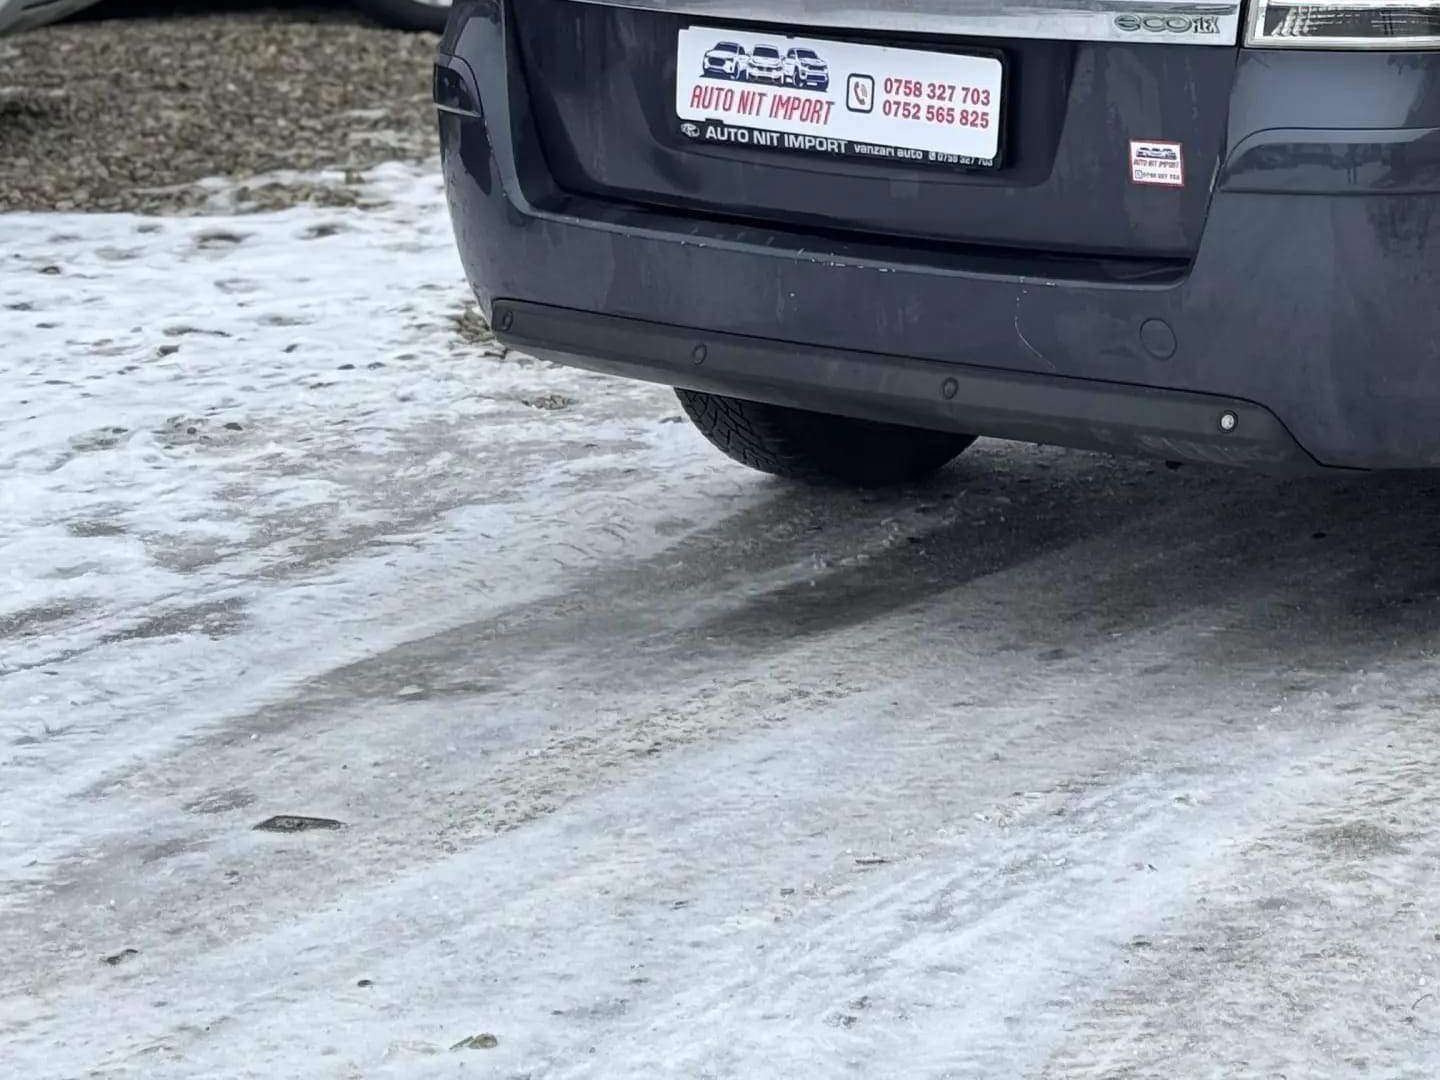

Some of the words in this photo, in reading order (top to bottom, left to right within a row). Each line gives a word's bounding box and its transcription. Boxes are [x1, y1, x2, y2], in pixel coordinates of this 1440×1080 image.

[689, 84, 735, 112] AUTO
[737, 89, 768, 117] NIT
[768, 94, 836, 125] IMPORT
[883, 77, 923, 98] 0758
[926, 83, 957, 103] 327
[961, 86, 991, 106] 703
[882, 99, 921, 120] 0752
[925, 104, 956, 124] 565
[959, 109, 990, 129] 825
[705, 126, 749, 143] AUTO
[753, 130, 780, 146] NIT
[785, 134, 848, 154] IMPORT
[854, 142, 895, 157] vanzari
[897, 147, 923, 160] auto
